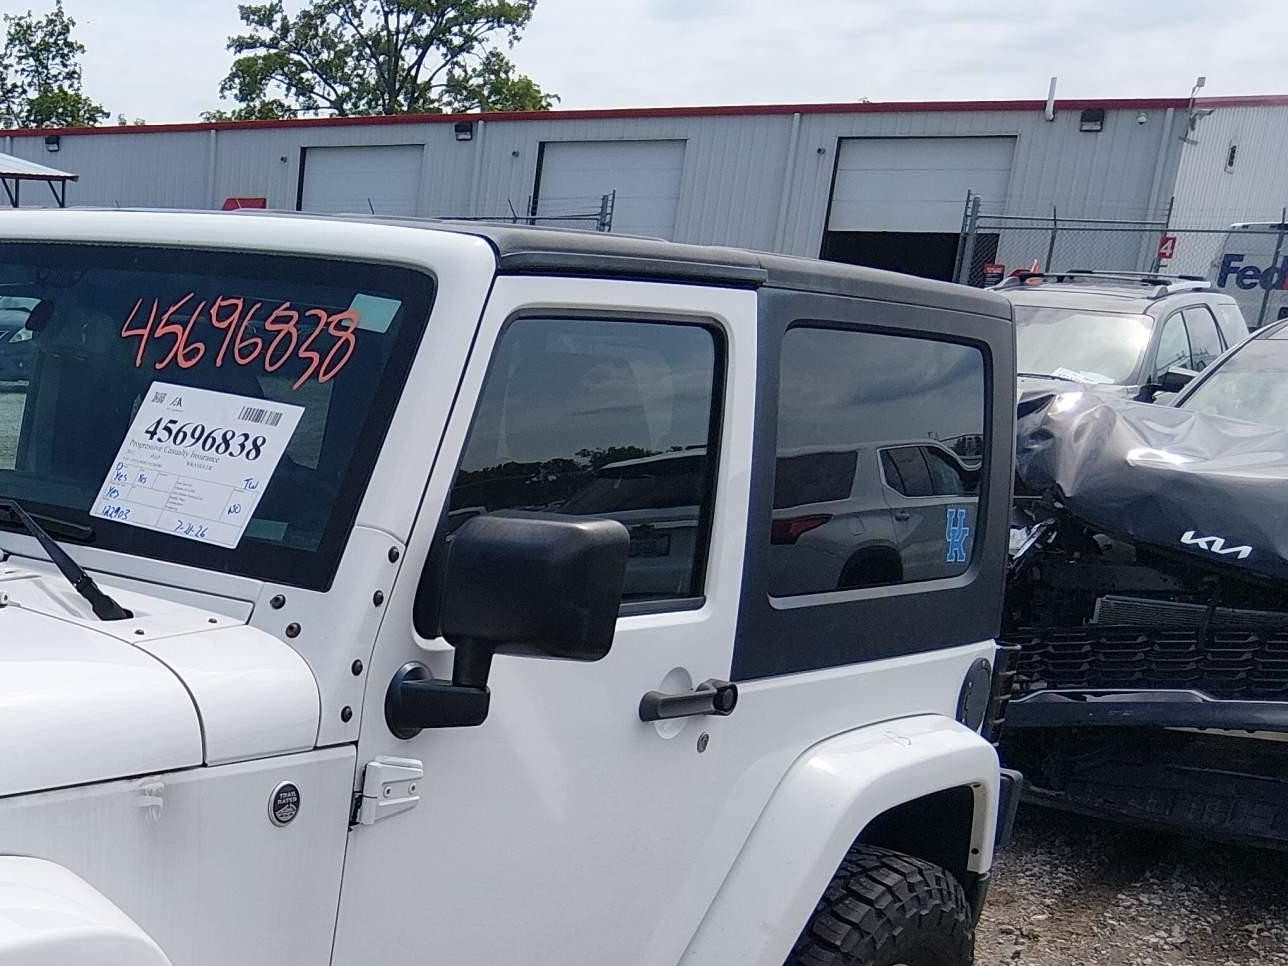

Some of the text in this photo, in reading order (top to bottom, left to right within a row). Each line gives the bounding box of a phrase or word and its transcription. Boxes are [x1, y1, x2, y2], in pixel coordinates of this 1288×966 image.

[1159, 239, 1173, 257] 4
[1216, 253, 1288, 291] Fed
[120, 292, 361, 391] 45696838
[143, 416, 267, 462] 45696838
[113, 471, 128, 482] Yes
